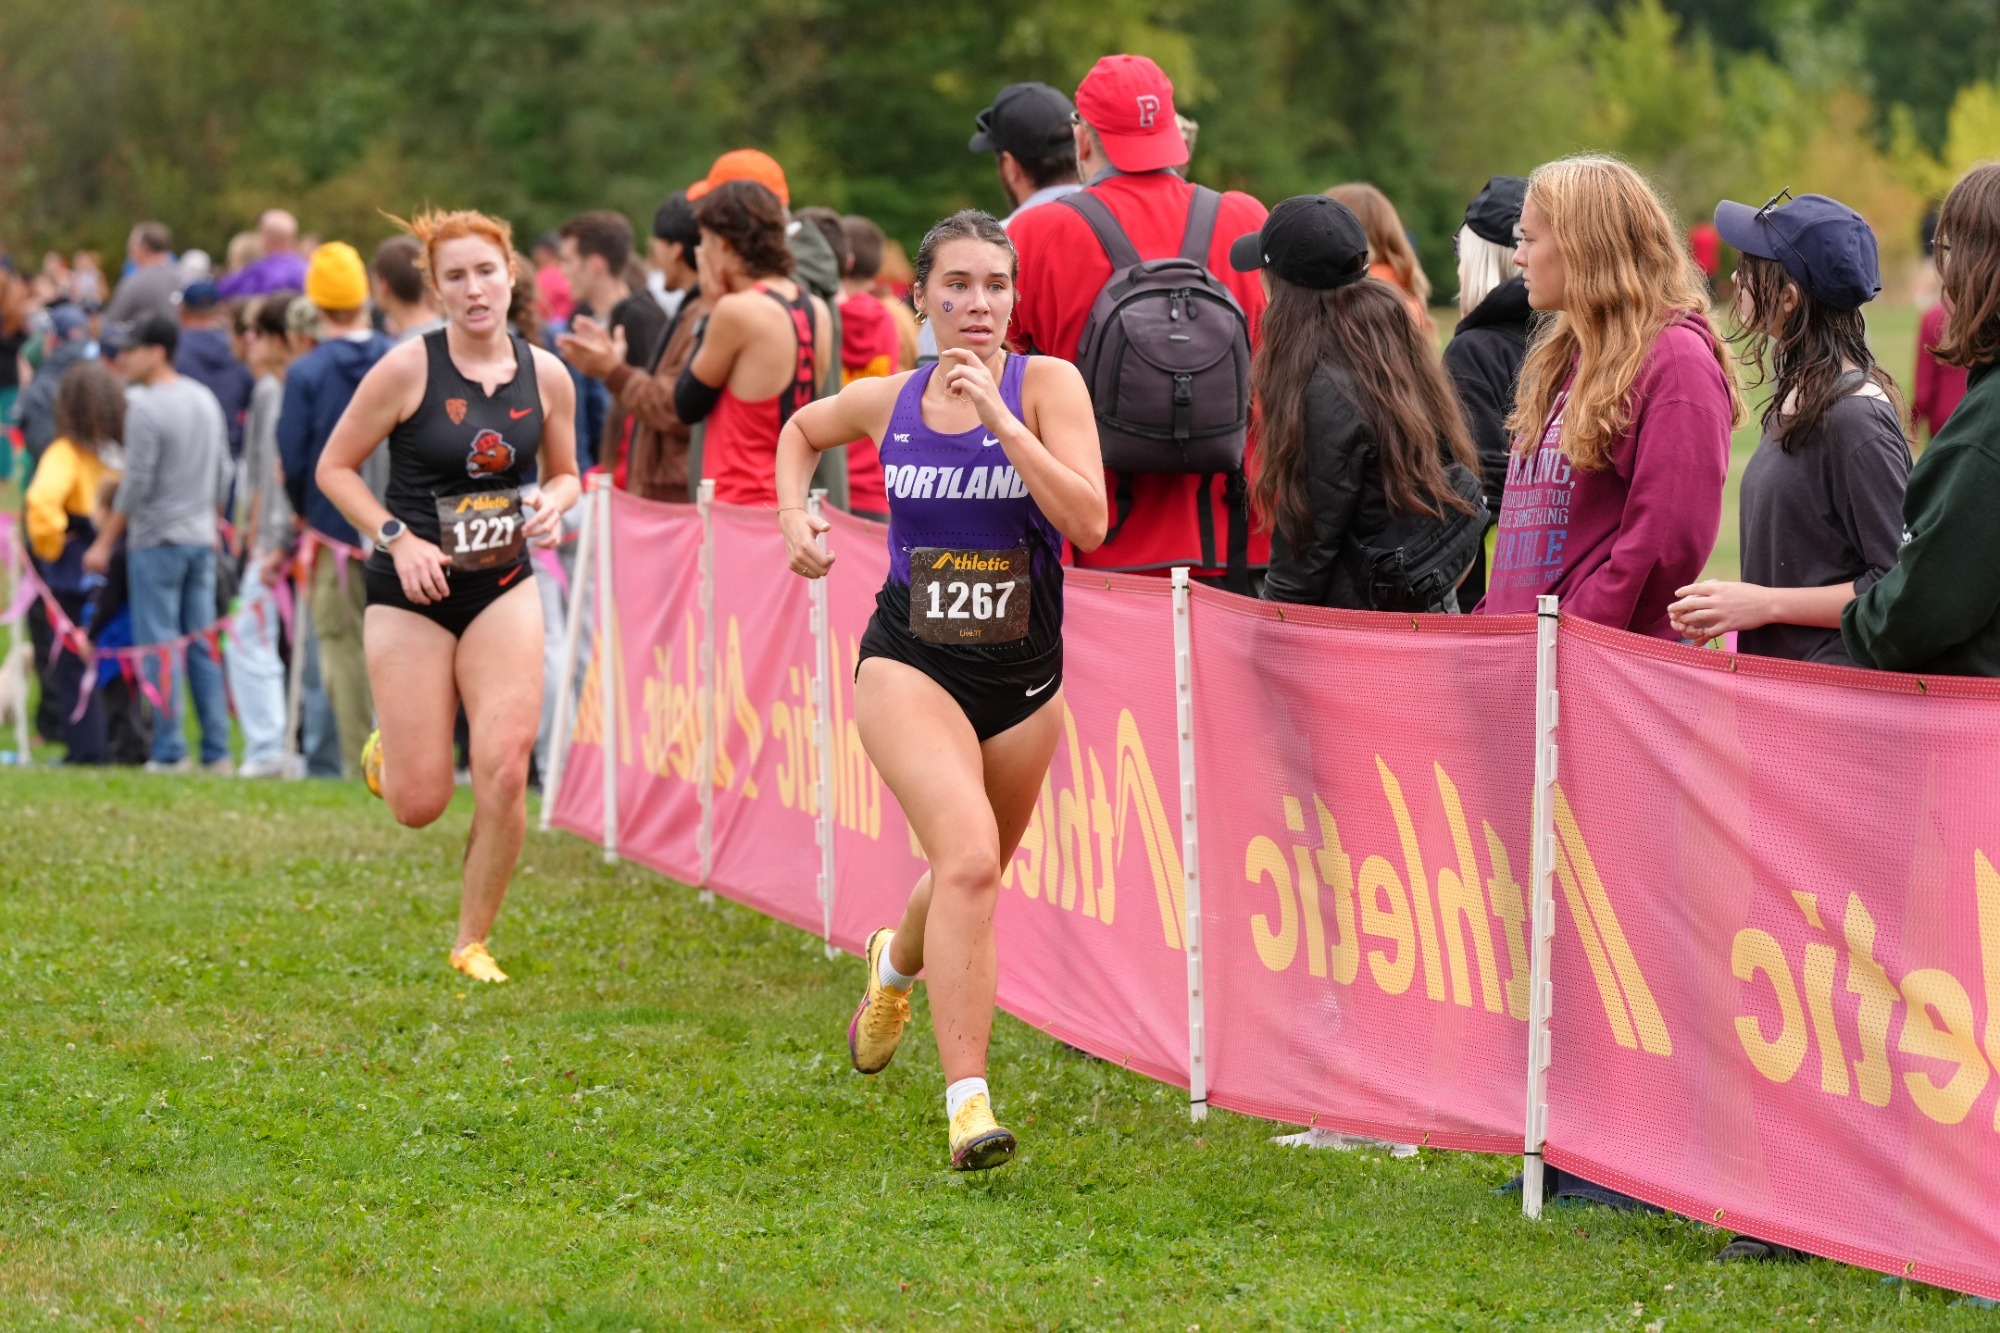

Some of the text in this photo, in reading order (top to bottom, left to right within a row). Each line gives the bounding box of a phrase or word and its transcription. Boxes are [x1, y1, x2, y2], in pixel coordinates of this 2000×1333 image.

[1136, 95, 1160, 127] P
[885, 464, 1029, 501] PORTLAND
[455, 496, 510, 514] Athletic
[1545, 489, 1571, 506] TOO
[1513, 508, 1569, 528] SOMETHING
[931, 552, 1010, 571] Athletic
[926, 581, 1016, 620] 1267
